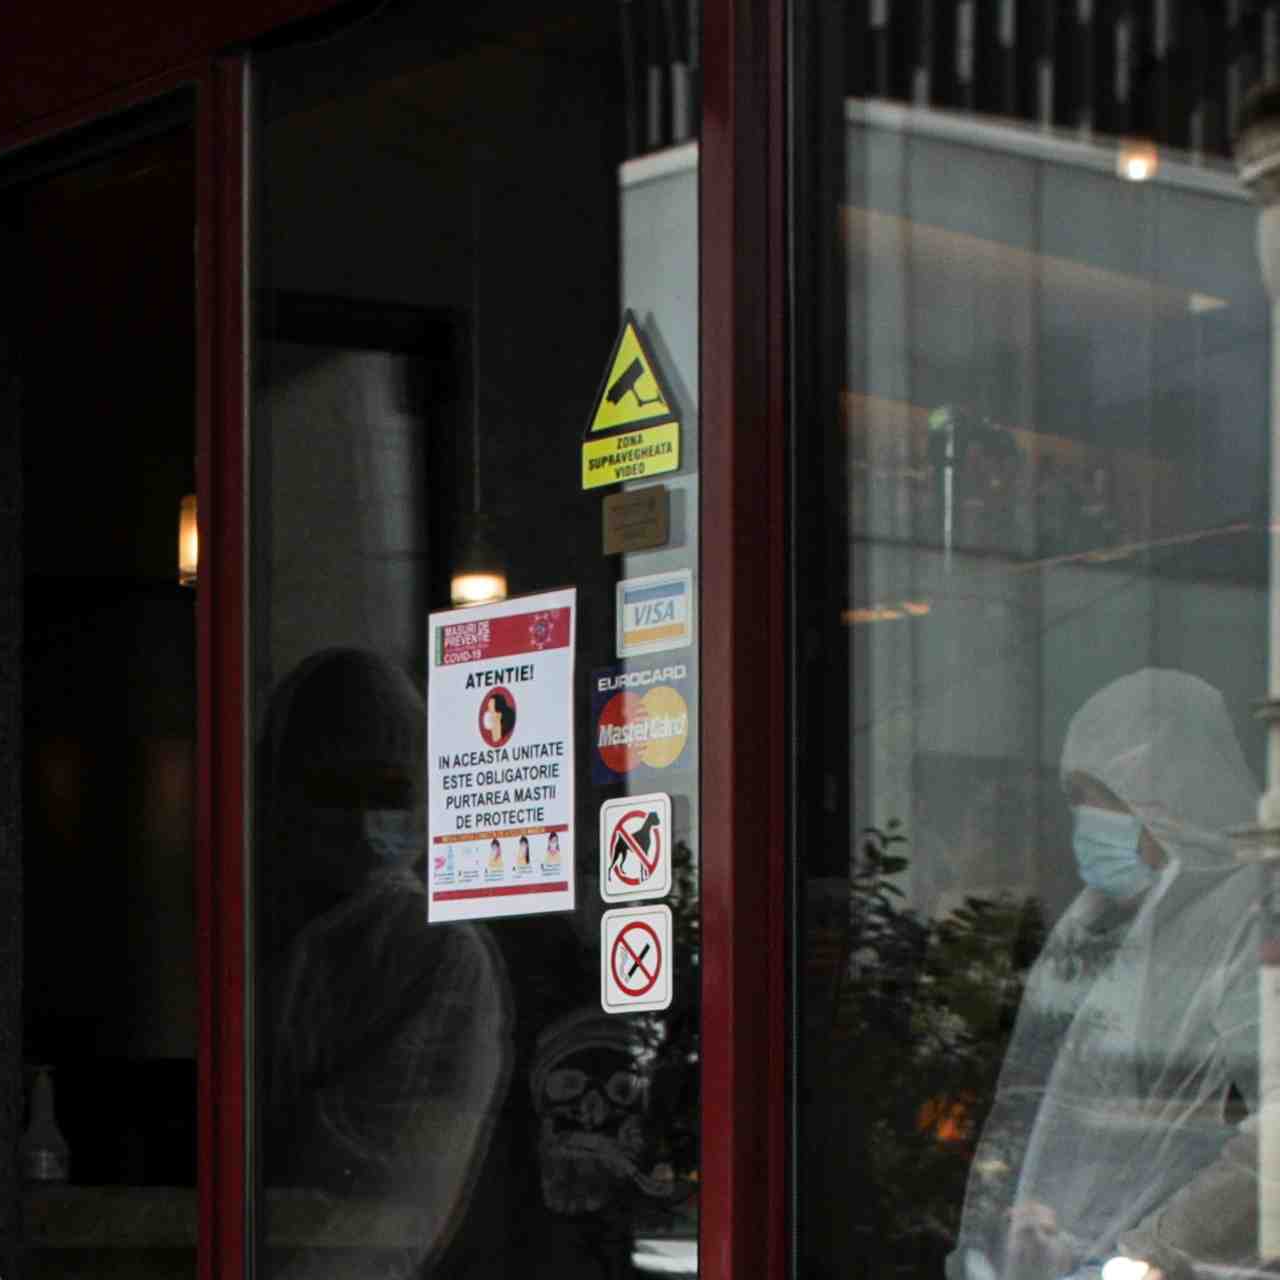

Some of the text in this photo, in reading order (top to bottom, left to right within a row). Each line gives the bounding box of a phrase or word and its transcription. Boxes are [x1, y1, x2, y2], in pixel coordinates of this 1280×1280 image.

[616, 434, 644, 450] ZONA
[614, 462, 646, 480] VIDEO
[634, 602, 675, 628] VISA
[597, 664, 688, 692] EUROCARD
[596, 714, 687, 748] MasterCard
[438, 756, 451, 769] IN
[512, 741, 564, 761] UNITATE
[442, 763, 560, 790] ESTE OBLIGATORIE
[446, 790, 512, 809] PURTAREA
[456, 807, 545, 829] DE PROTECTIE
